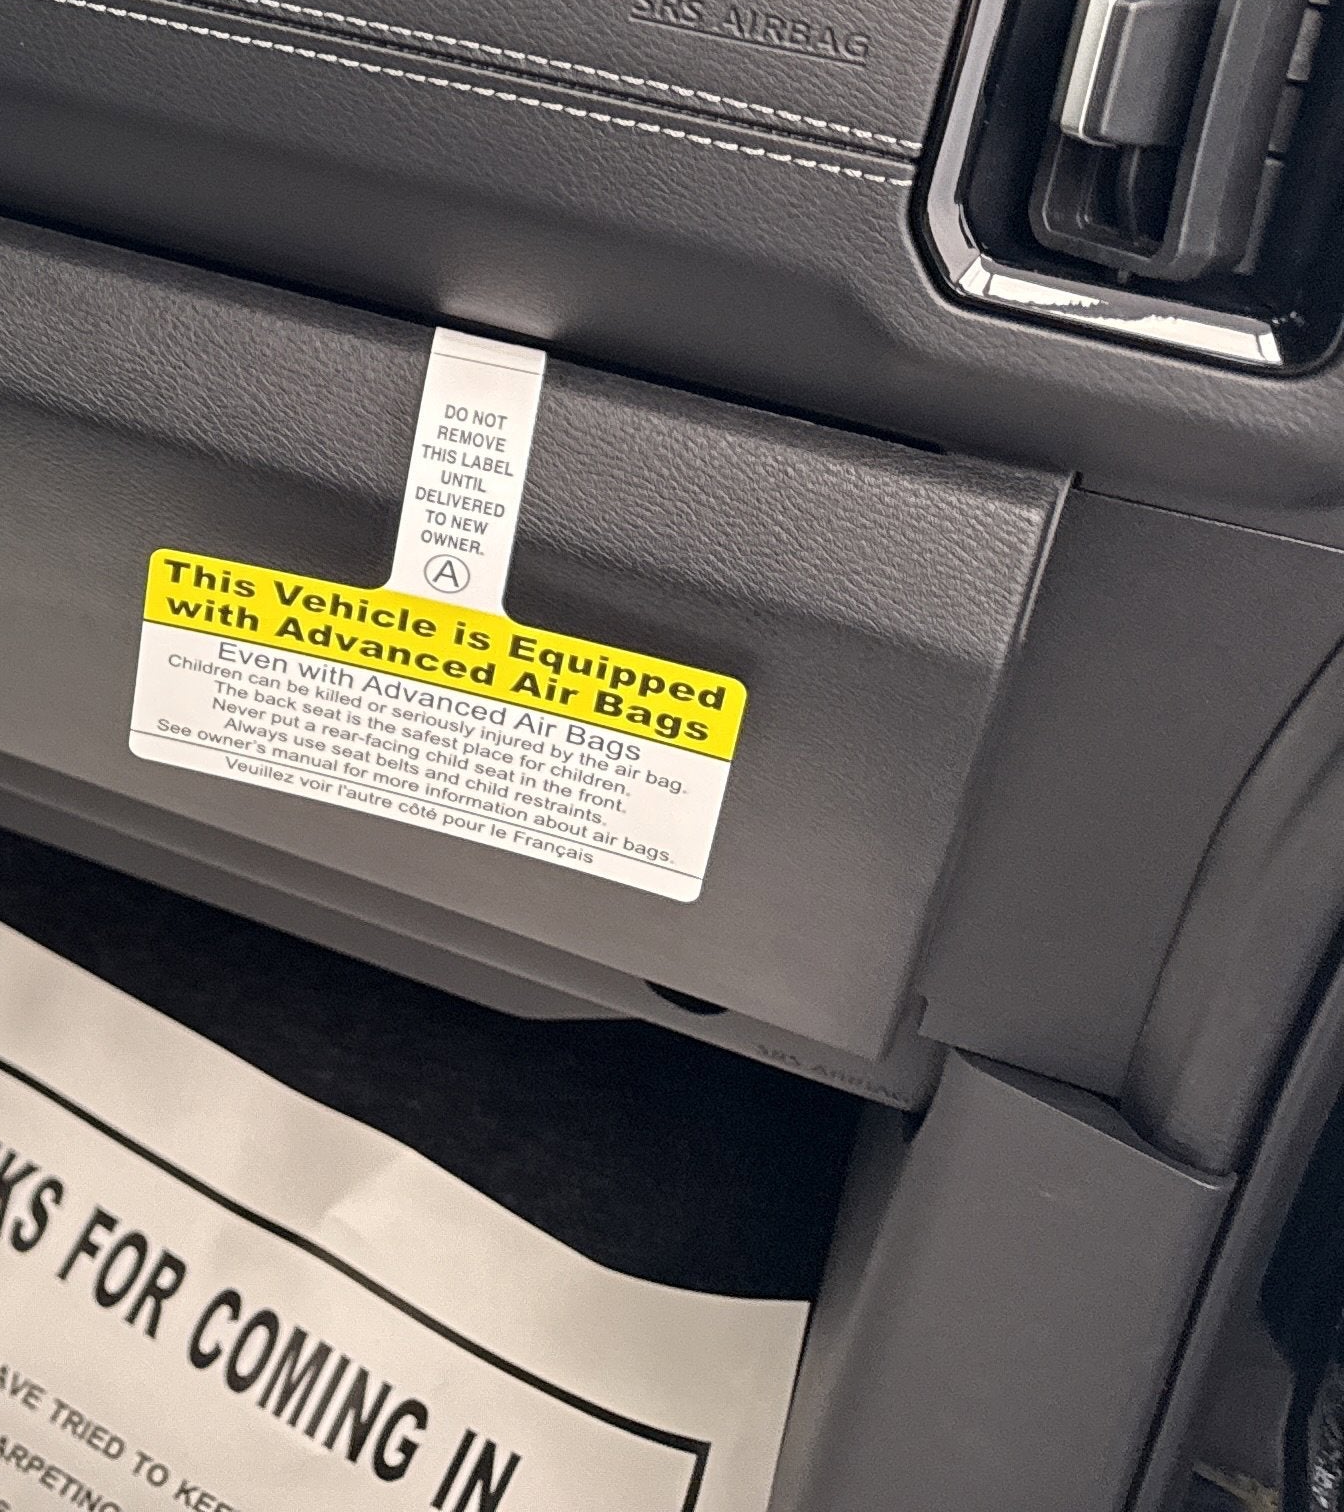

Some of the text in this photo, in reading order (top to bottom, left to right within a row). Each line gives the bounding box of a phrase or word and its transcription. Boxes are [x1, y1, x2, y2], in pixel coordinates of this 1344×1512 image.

[723, 3, 871, 58] AIRBAG
[421, 443, 514, 477] THIS LABEL
[436, 424, 507, 453] REMOVE
[444, 403, 509, 430] DO NOT
[414, 485, 505, 518] DELIVERED
[425, 508, 489, 535] TO NEW
[440, 469, 487, 494] UNTIL
[420, 529, 484, 556] OWNER.
[163, 558, 727, 711] This Vehicle is Equipped
[166, 597, 709, 741] with Advanced Air Bags
[168, 653, 687, 795] Children can be killed or seriously injured by the air bag.
[212, 696, 627, 814] Never put a rear-facing child seat in the front.
[214, 679, 631, 797] The back seat is the safest place for children.
[218, 641, 641, 761] Even with Advanced Air Bags
[156, 718, 674, 864] See owner's manual for more information about air bags.
[223, 717, 607, 826] Always use seat belts and child restraints.
[225, 755, 594, 864] Veuillez voir l'autre côté pour le Français
[57, 1205, 187, 1340] FOR
[188, 1288, 429, 1483] COMING
[430, 1427, 522, 1512] IN
[49, 1398, 125, 1461] TRIED
[132, 1450, 170, 1488] TO
